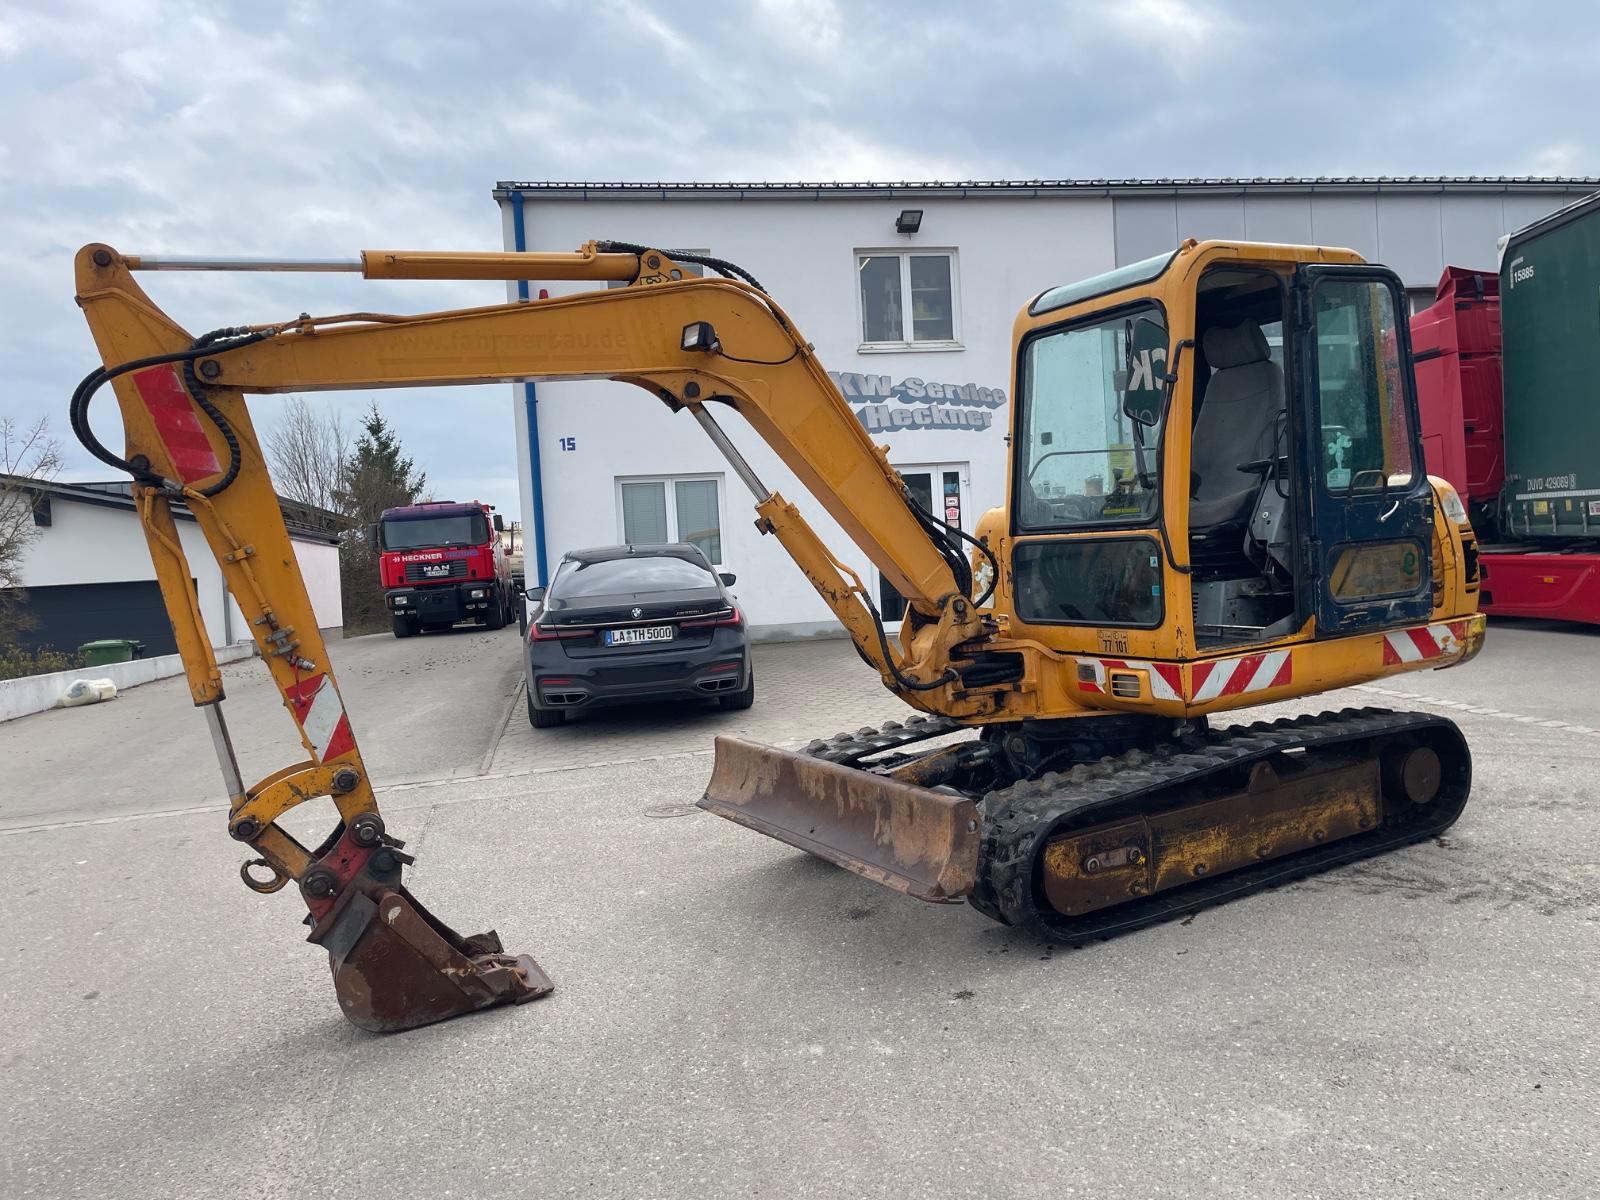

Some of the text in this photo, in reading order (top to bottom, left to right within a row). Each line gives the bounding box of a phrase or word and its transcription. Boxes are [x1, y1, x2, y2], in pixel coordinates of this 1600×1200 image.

[1514, 266, 1534, 283] 15885
[827, 371, 1007, 409] KW-Service
[858, 404, 993, 433] Heckner
[559, 437, 576, 451] 15
[402, 553, 443, 562] HECKNER
[423, 564, 450, 572] MAN
[612, 627, 672, 642] LA TH 5000
